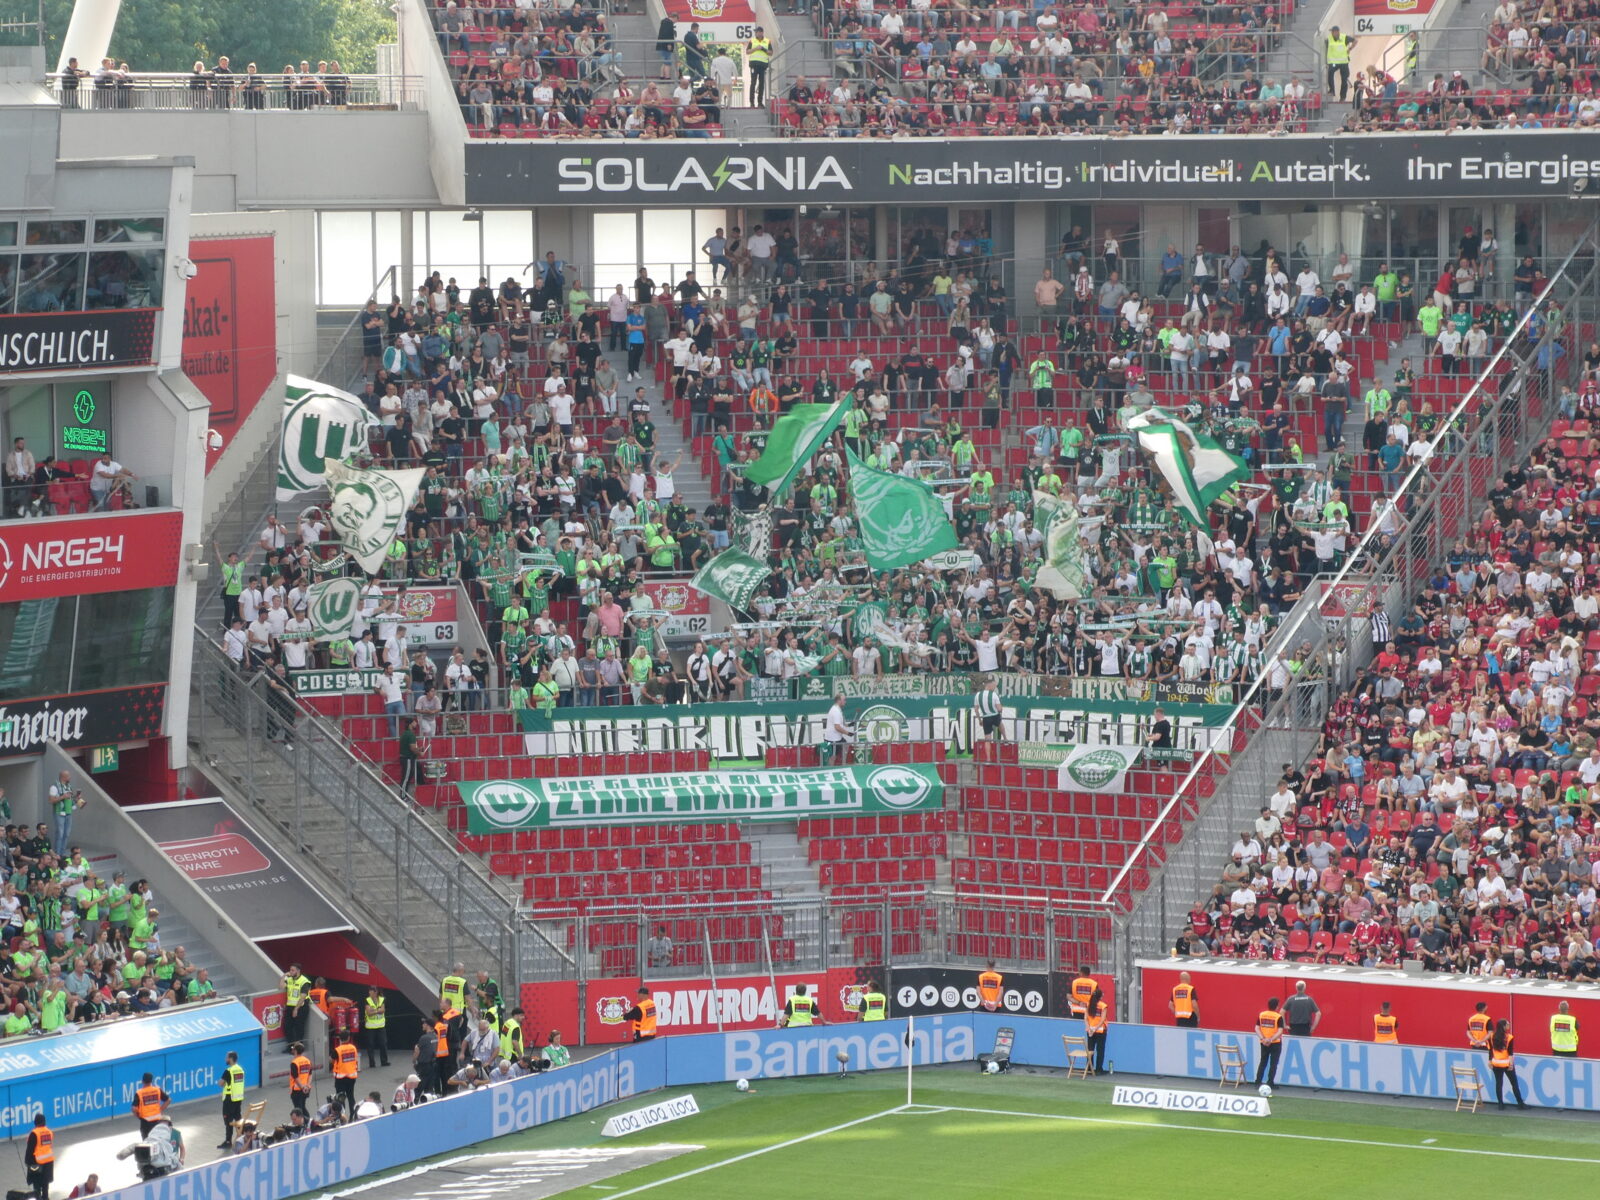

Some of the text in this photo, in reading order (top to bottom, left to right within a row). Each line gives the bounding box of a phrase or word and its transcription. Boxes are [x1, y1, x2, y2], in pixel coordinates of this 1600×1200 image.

[736, 25, 753, 39] G5
[1357, 18, 1374, 32] G4
[558, 155, 853, 193] SOLARNIA
[889, 161, 1071, 189] Nachhaltig.
[1081, 158, 1242, 184] Individuell.
[1250, 156, 1371, 183] Autark.
[1408, 156, 1452, 181] Ihr
[63, 426, 106, 446] NRG24
[21, 534, 124, 571] NRG24
[20, 567, 121, 584] DIE ENERGIEDISTRIBUTION
[434, 624, 454, 640] G3
[688, 617, 707, 632] G2
[549, 771, 849, 793] WIR GLAUBEN AN UNSER
[724, 1016, 974, 1081] Barmenia
[1186, 1031, 1386, 1092] EINACH.
[54, 1086, 117, 1118] EINFACH.
[122, 1066, 219, 1101] MESCHLICH.
[492, 1052, 635, 1138] Barmenia
